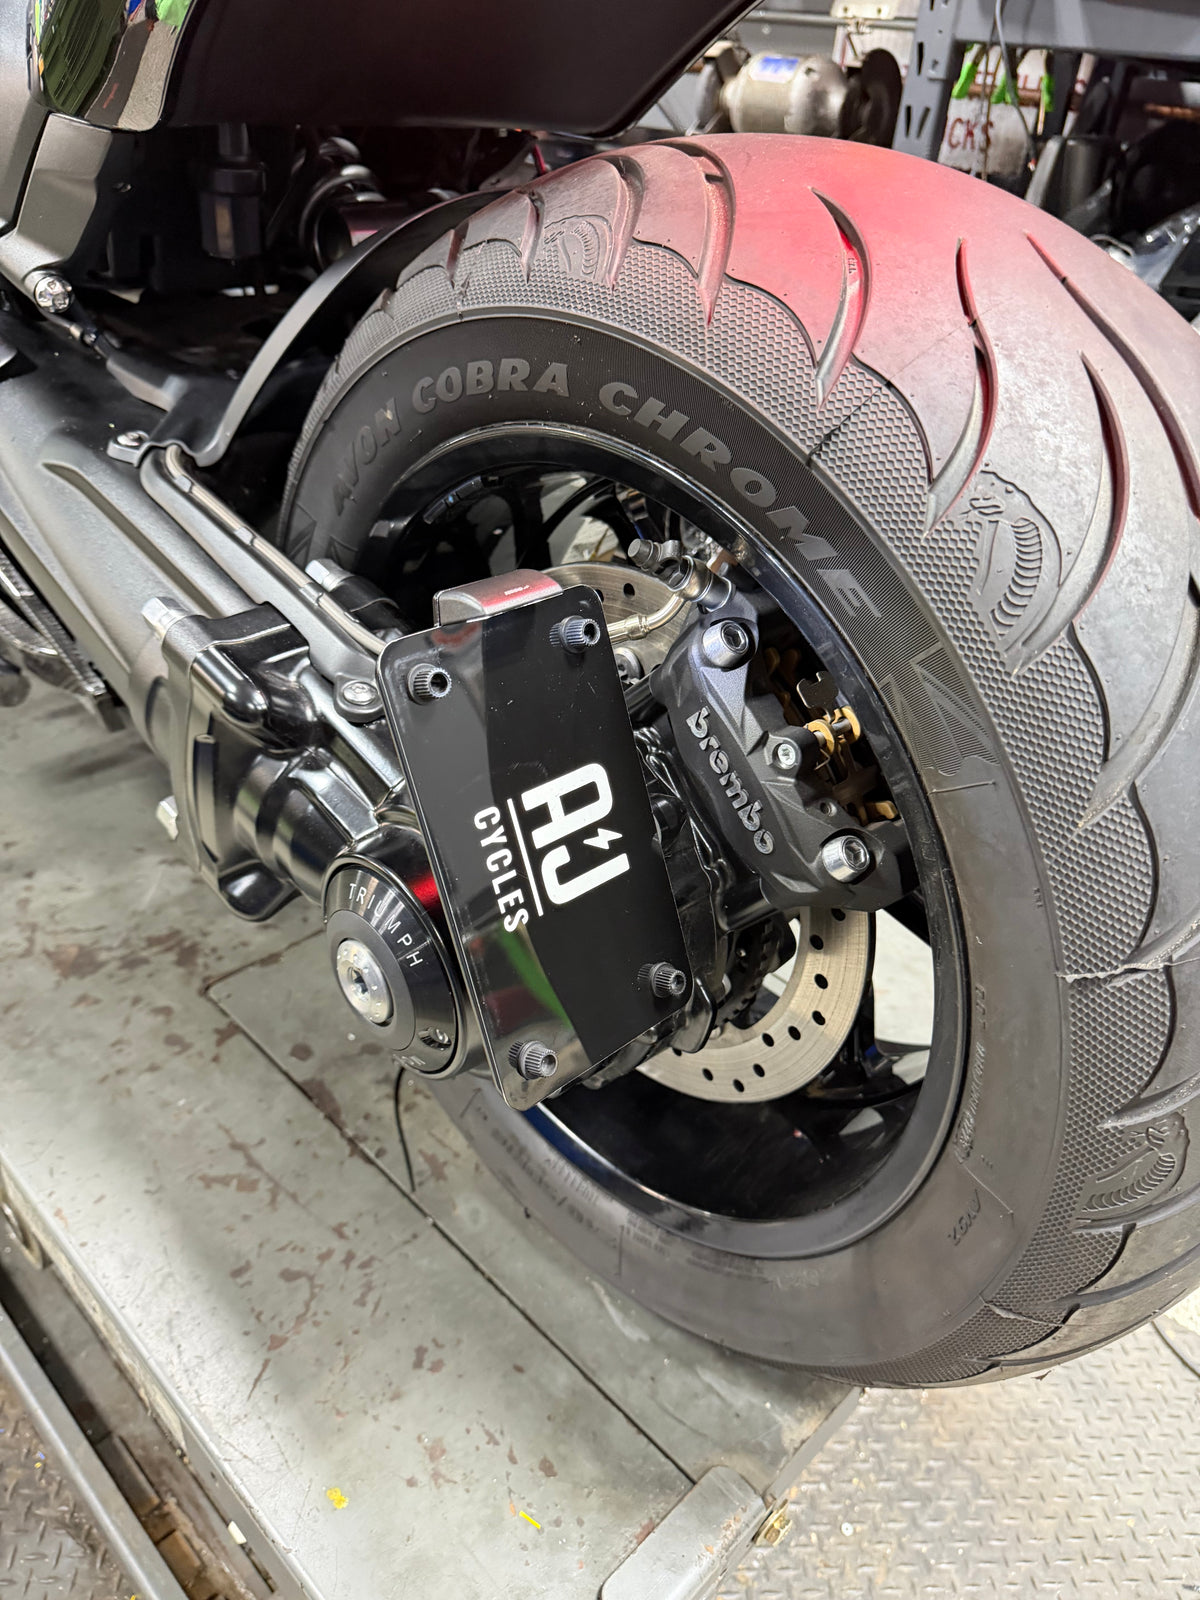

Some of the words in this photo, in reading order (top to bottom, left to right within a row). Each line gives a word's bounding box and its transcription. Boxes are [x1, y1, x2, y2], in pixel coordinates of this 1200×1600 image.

[332, 397, 402, 517] AVON
[411, 357, 570, 414] COBRA
[598, 381, 882, 619] CHROME
[520, 762, 631, 905] AJ
[685, 705, 775, 856] brembo
[348, 882, 424, 968] TRIUMPH
[473, 805, 530, 933] CYCLES
